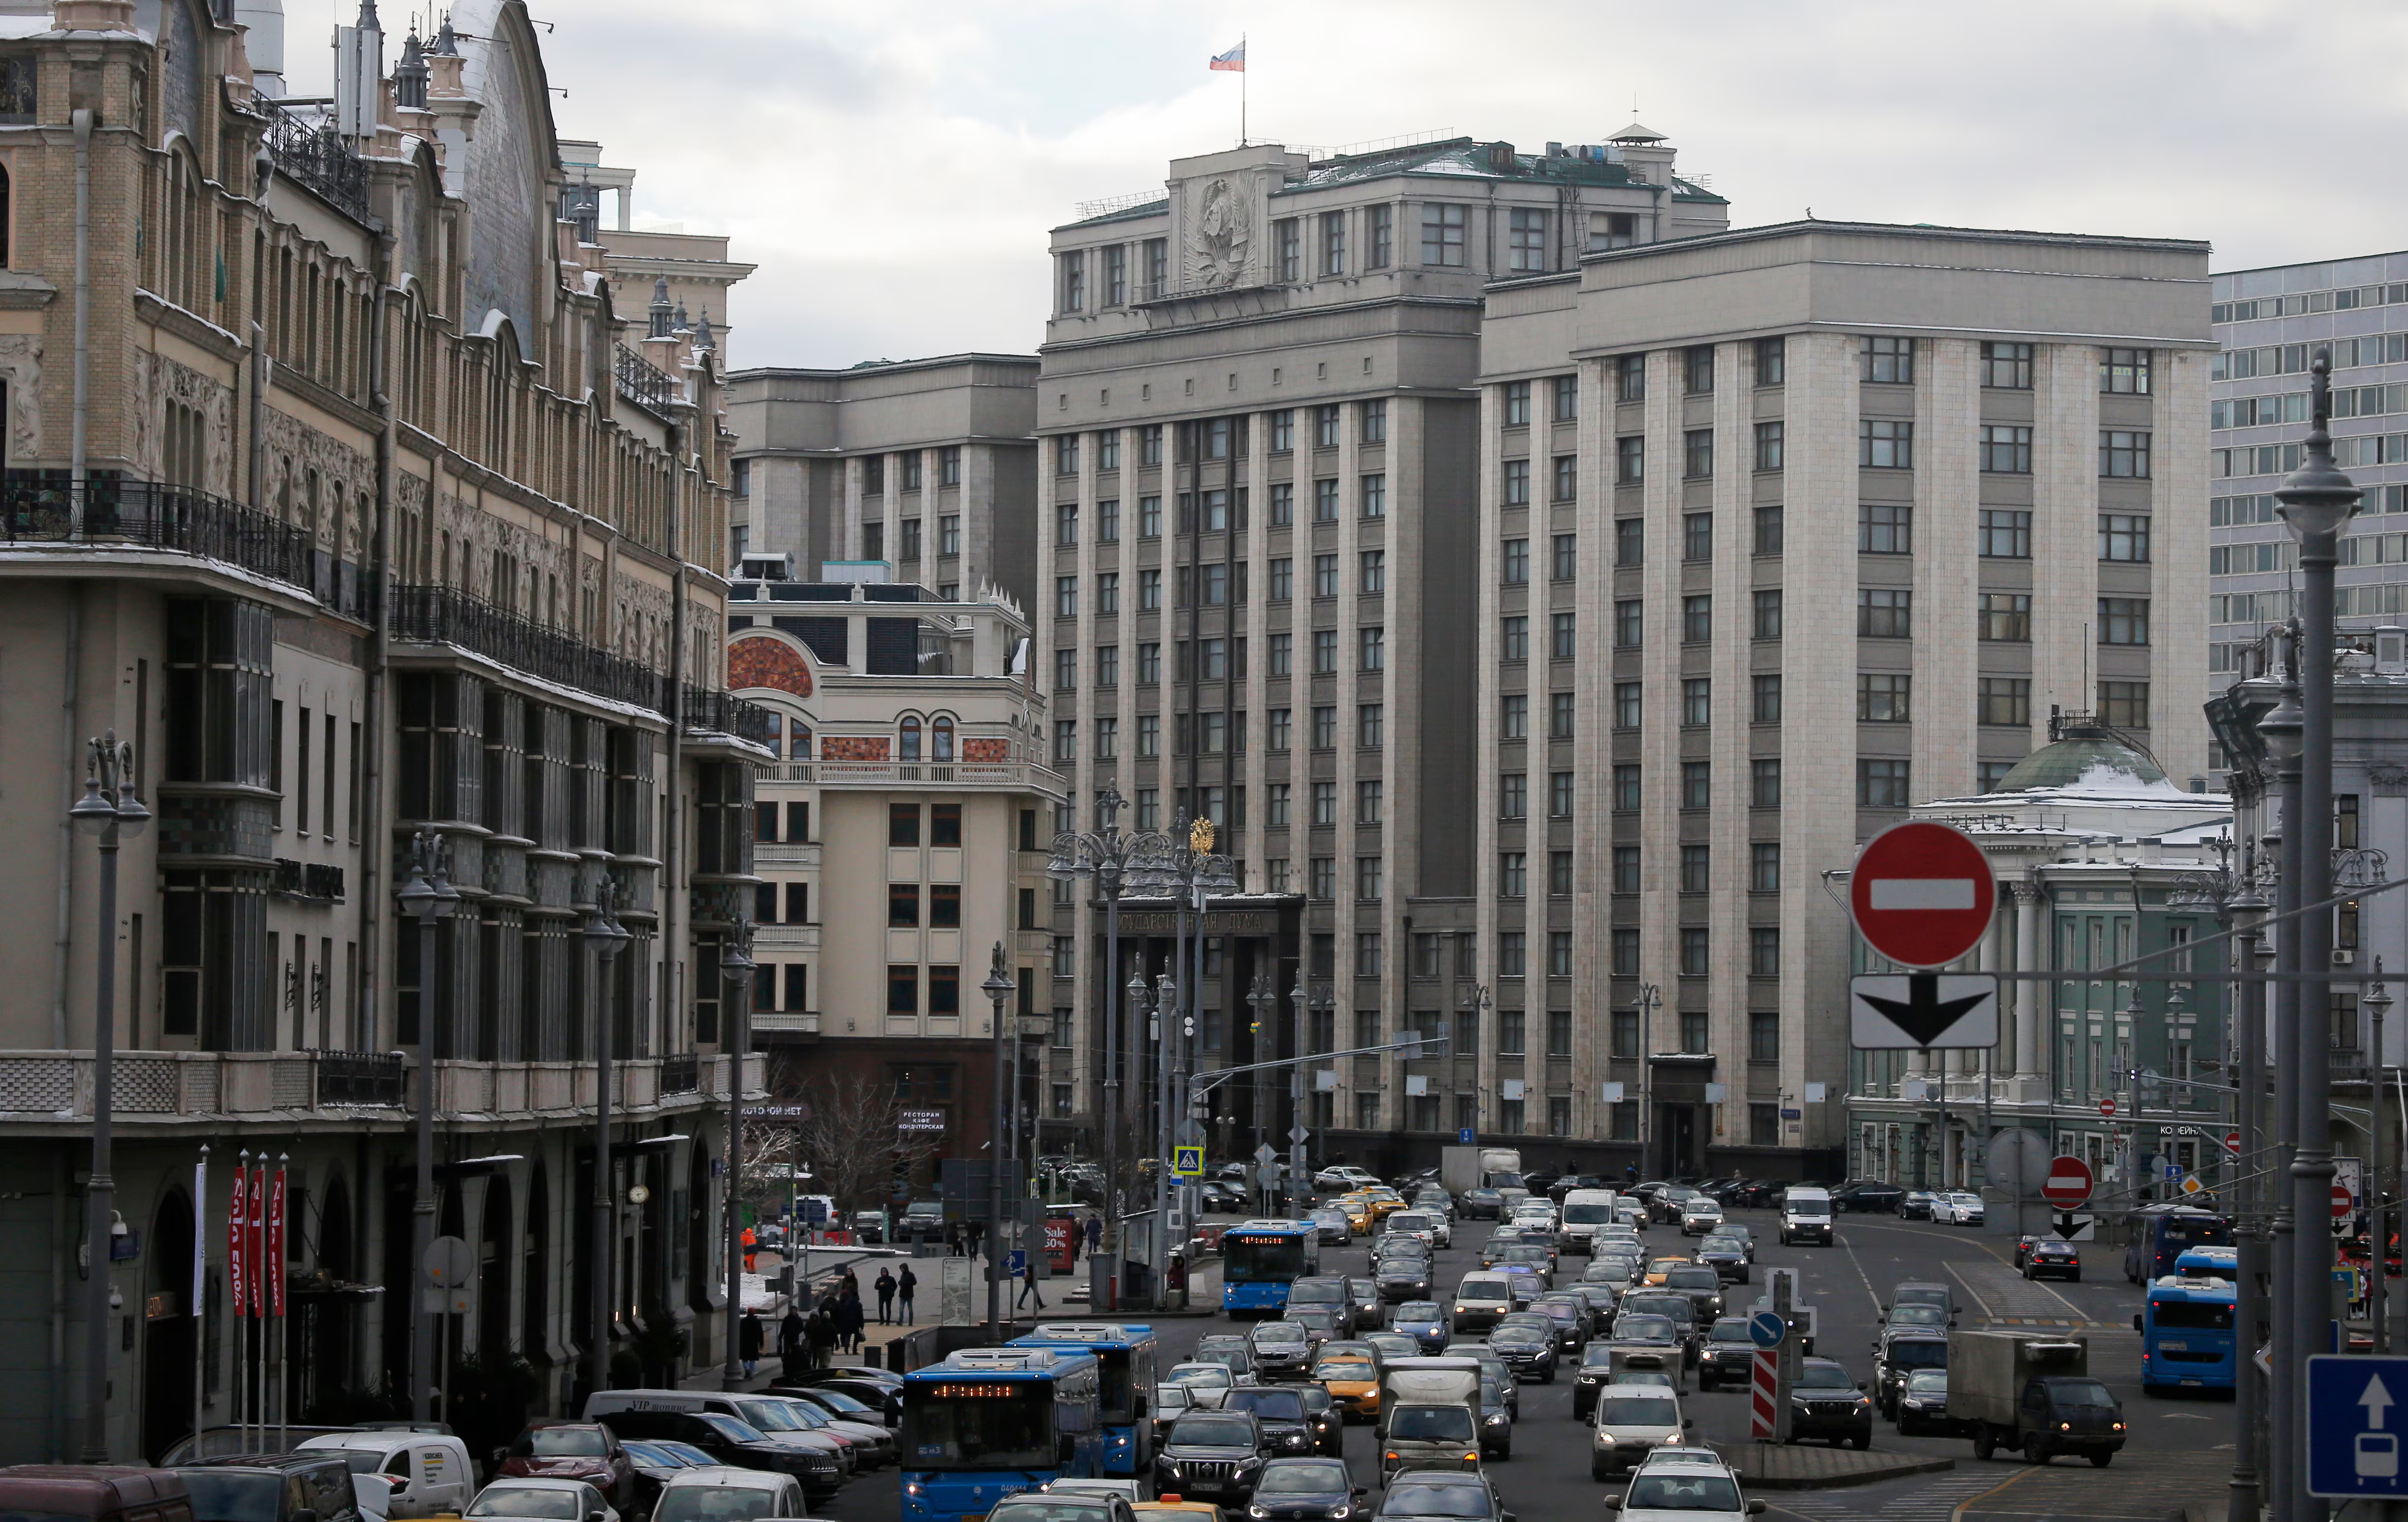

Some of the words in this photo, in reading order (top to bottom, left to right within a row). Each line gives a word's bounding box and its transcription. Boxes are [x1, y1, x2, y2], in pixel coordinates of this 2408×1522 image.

[1117, 914, 1217, 931] СУДАРСТВНАЯ
[1229, 914, 1262, 931] ДУМА
[2160, 1126, 2201, 1135] КОЕЙНЯ
[1045, 1227, 1066, 1237] Sale
[633, 1400, 650, 1410] VIP
